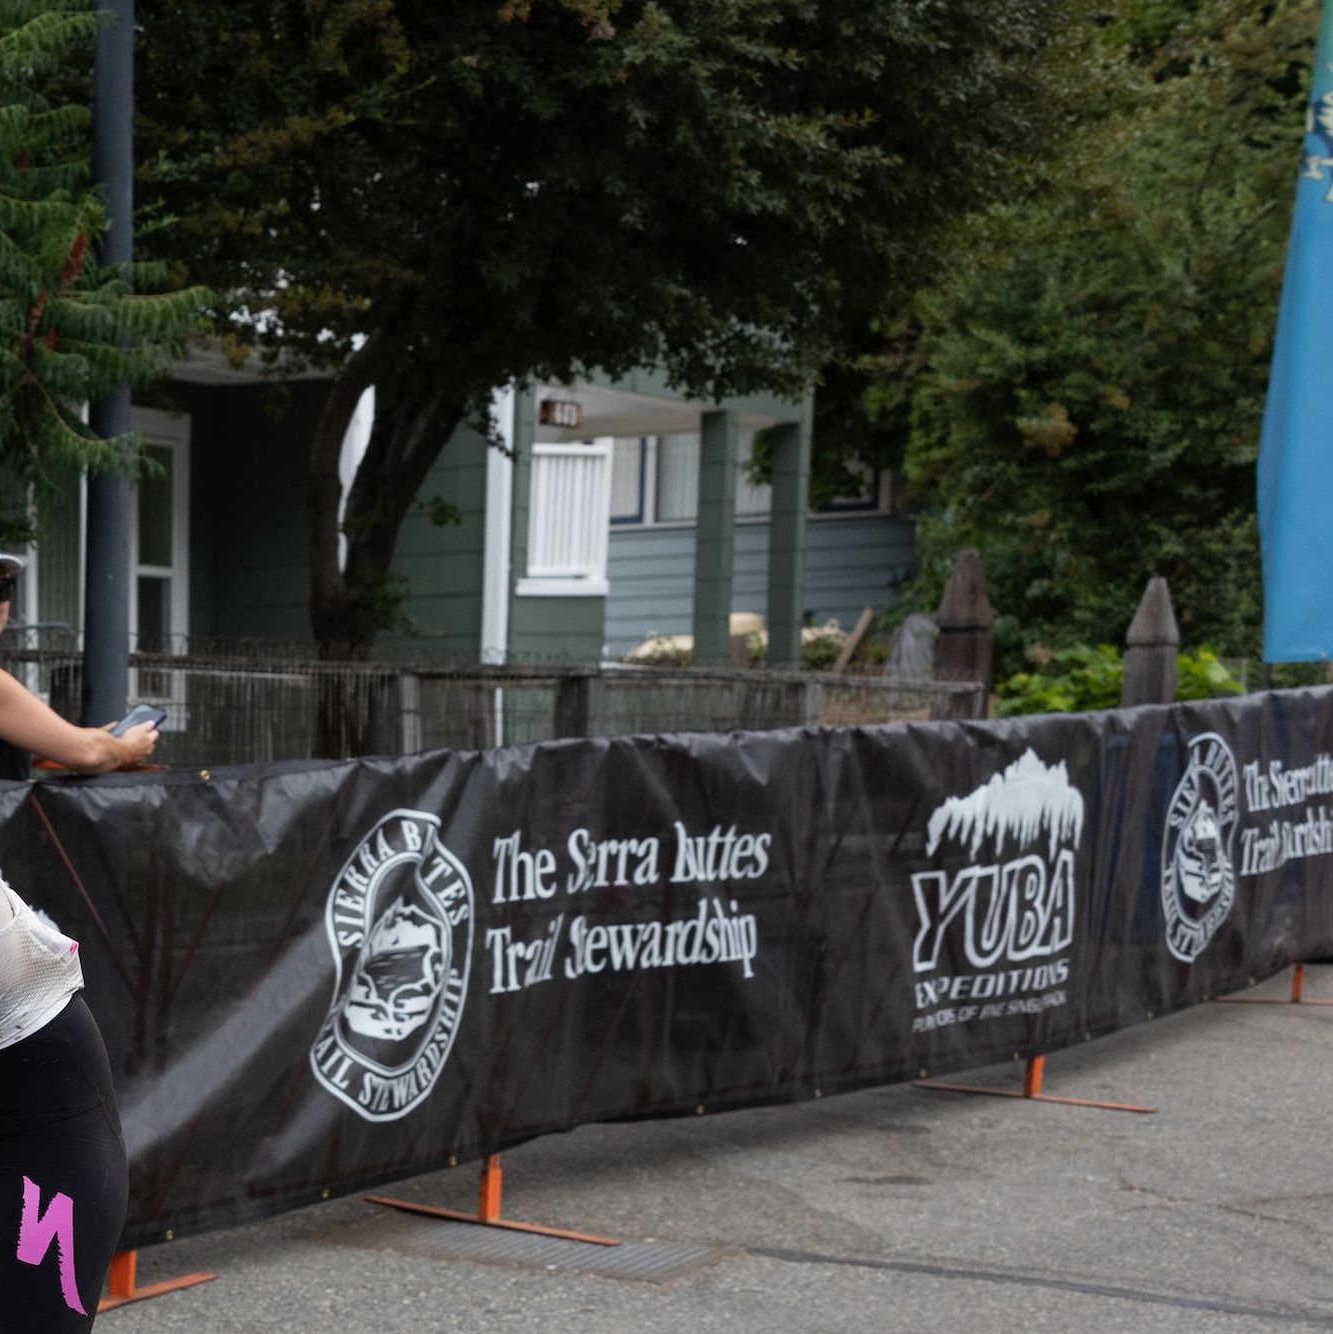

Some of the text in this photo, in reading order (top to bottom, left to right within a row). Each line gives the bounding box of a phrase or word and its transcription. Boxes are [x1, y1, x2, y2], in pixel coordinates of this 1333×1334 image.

[334, 827, 396, 949] SIERRA
[492, 829, 558, 904] The
[910, 849, 1076, 973] YUBA
[486, 912, 565, 995] Trail
